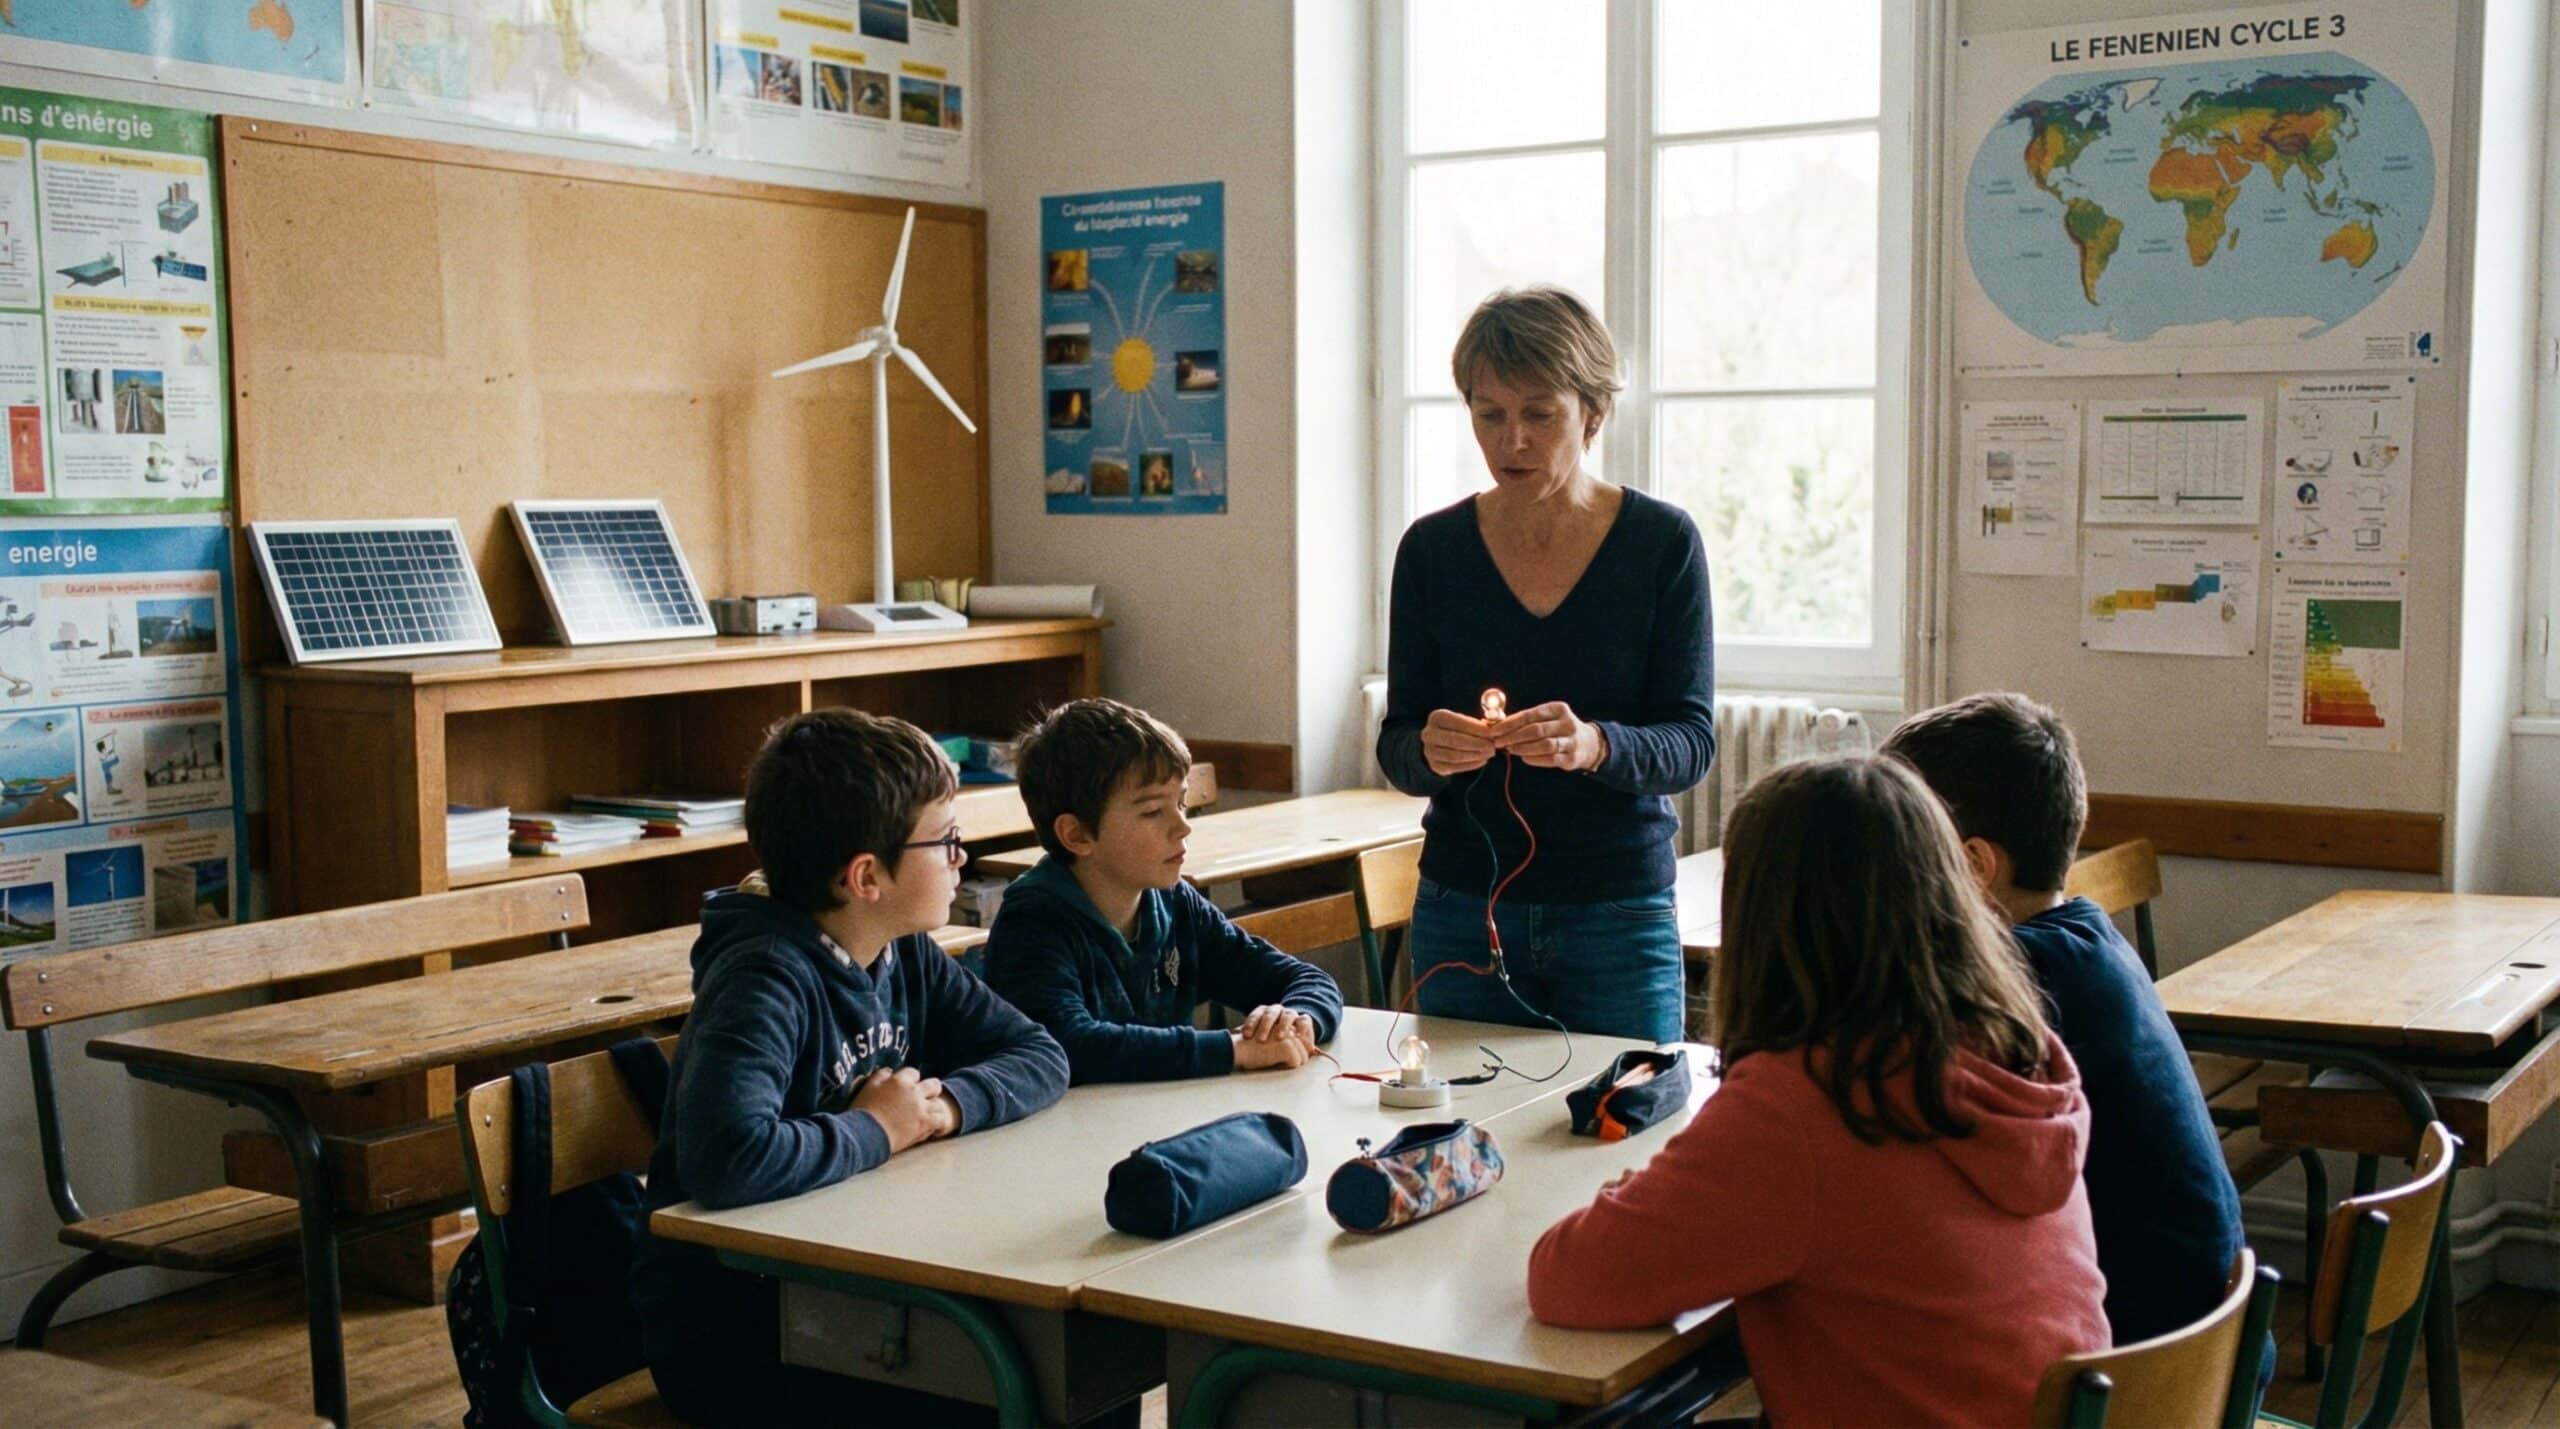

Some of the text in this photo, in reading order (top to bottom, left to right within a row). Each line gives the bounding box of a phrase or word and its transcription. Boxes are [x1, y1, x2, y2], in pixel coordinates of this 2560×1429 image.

[2051, 14, 2346, 62] LE FENENIEN CYCLE 3
[1, 104, 154, 141] ns d'enérgie
[8, 540, 98, 568] energie
